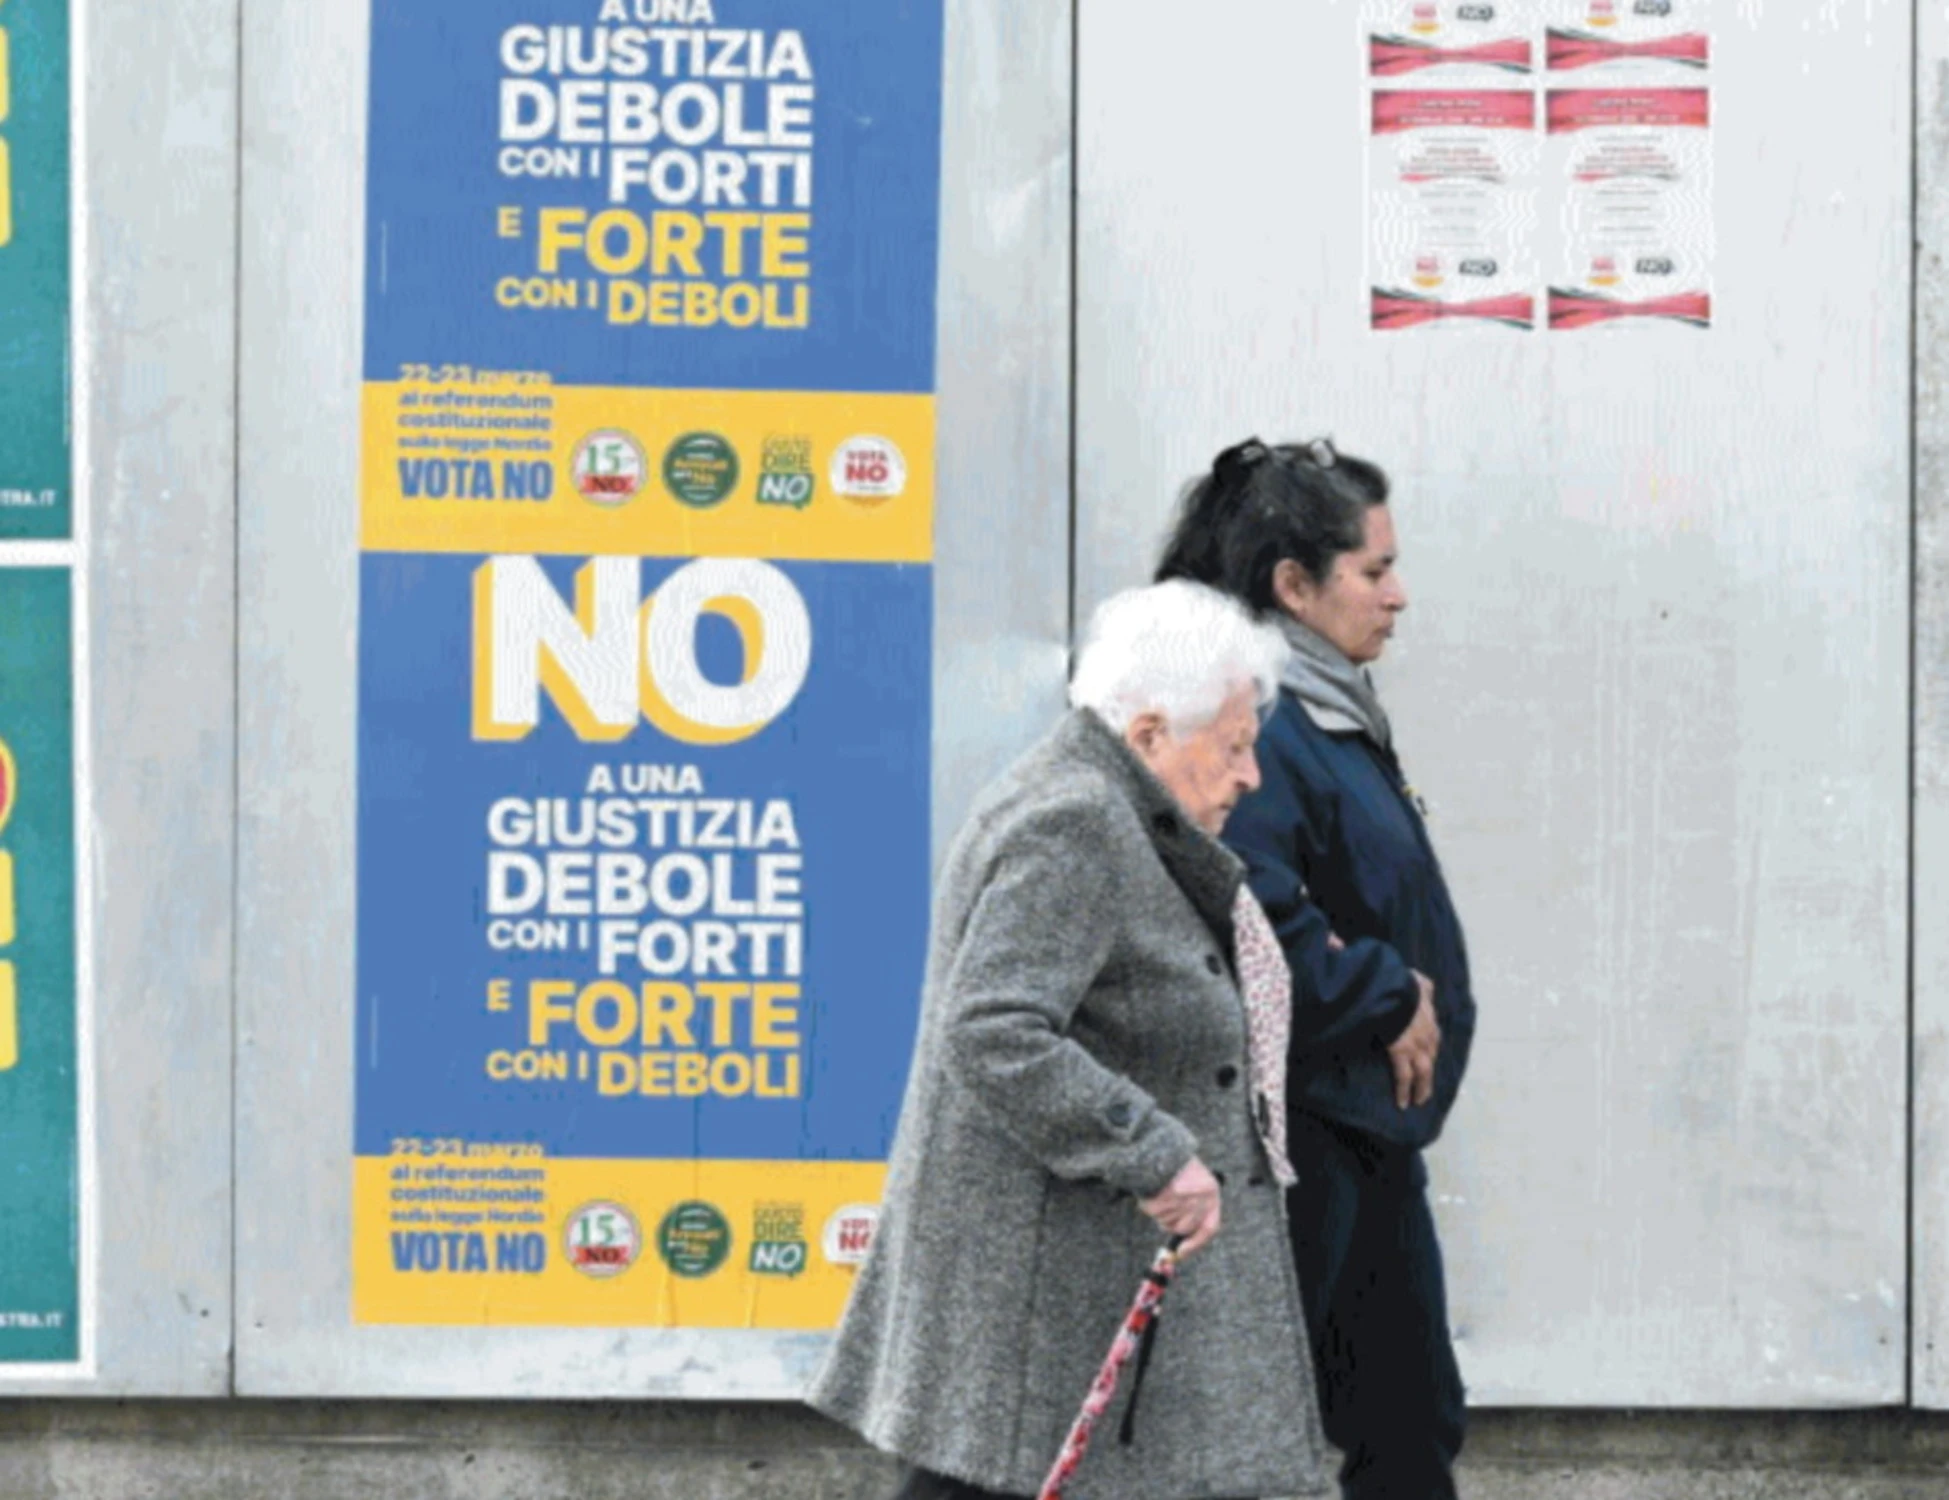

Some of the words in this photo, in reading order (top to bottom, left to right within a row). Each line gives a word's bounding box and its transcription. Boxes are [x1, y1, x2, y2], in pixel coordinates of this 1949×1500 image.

[599, 0, 628, 22] A
[634, 0, 716, 23] UNA
[500, 24, 813, 80] GIUSTIZIA
[499, 78, 814, 147] DEBOLE
[499, 146, 580, 178] CON
[590, 148, 600, 178] I
[609, 148, 811, 207] FORTI
[498, 206, 522, 237] E
[538, 207, 811, 278] FORTE
[496, 276, 577, 309] CON
[587, 280, 598, 309] I
[608, 279, 809, 329] DEBOLI
[421, 390, 553, 409] referendum
[398, 411, 552, 430] costituzionale
[586, 442, 622, 475] 15
[846, 463, 889, 483] NO
[398, 458, 495, 499] VOTA
[502, 460, 553, 501] NO
[593, 474, 628, 492] NO
[761, 474, 811, 501] NO
[472, 555, 811, 744] NO
[586, 764, 616, 793] A
[622, 764, 703, 793] UNA
[487, 798, 800, 848] GIUSTIZIA
[487, 851, 803, 916] DEBOLE
[487, 919, 569, 950] CON
[579, 920, 588, 950] I
[598, 920, 801, 976] FORTI
[487, 979, 511, 1011] E
[528, 980, 800, 1047] FORTE
[486, 1050, 568, 1080] CON
[578, 1051, 588, 1080] I
[597, 1051, 799, 1097] DEBOLI
[414, 1164, 545, 1181] referendum
[390, 1185, 544, 1203] costituzionale
[579, 1213, 614, 1247] 15
[390, 1231, 488, 1272] VOTA
[495, 1232, 545, 1273] NO
[585, 1247, 621, 1264] NO
[753, 1243, 802, 1271] NO
